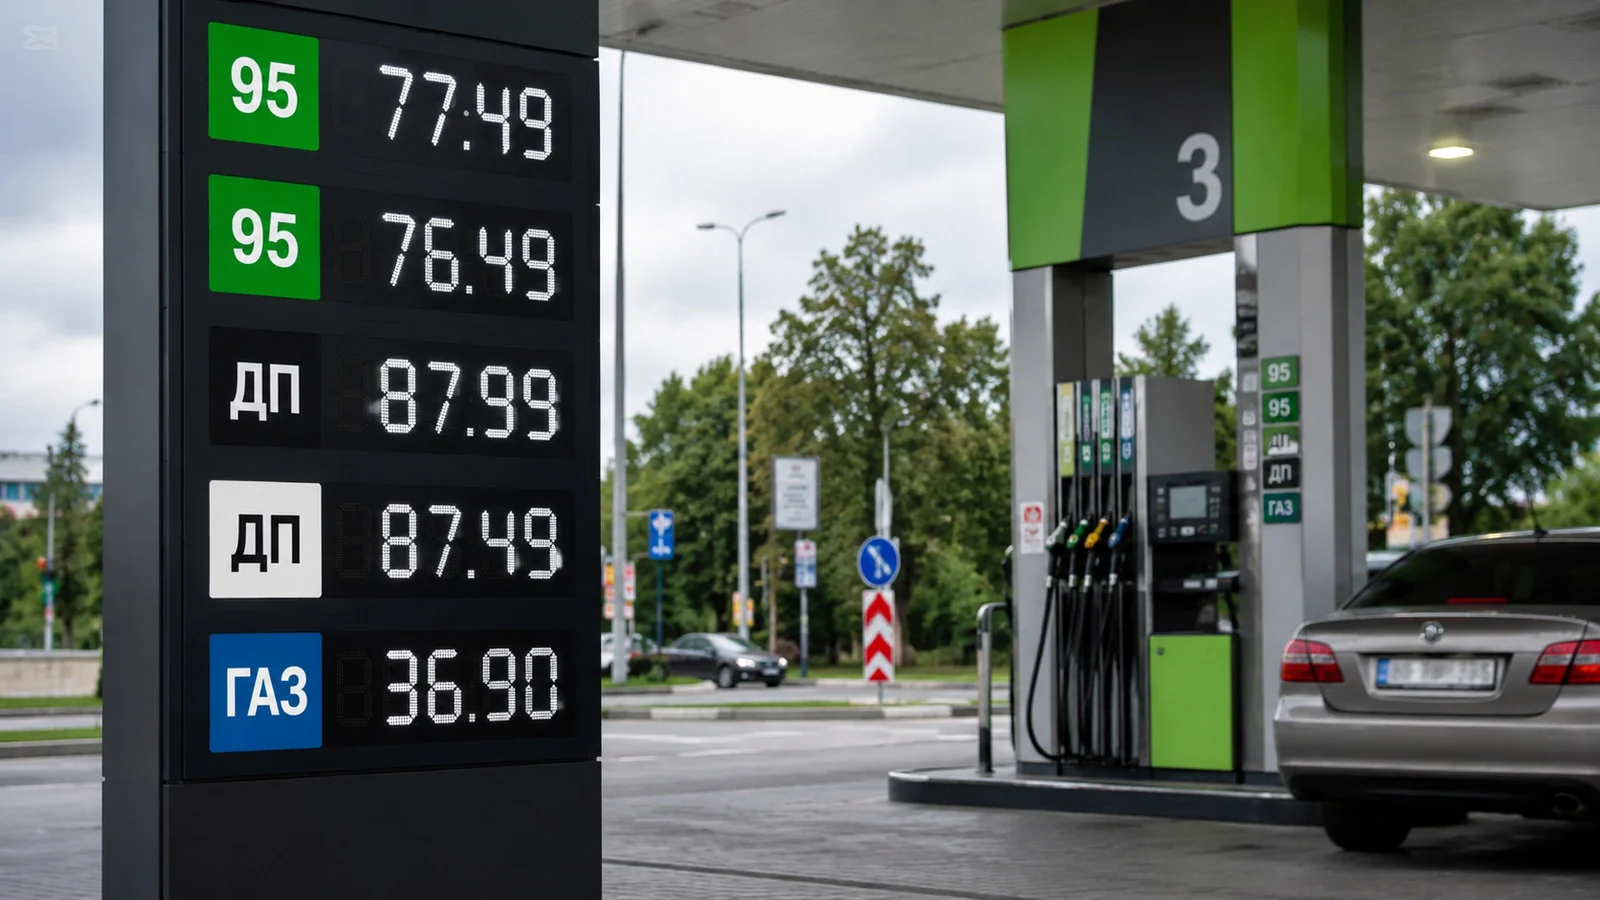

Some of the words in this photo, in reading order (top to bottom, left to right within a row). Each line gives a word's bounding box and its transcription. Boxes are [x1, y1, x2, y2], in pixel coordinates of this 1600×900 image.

[231, 56, 298, 119] 95
[379, 64, 553, 161] 77.49
[1176, 132, 1222, 221] 3
[231, 207, 299, 268] 95
[382, 212, 555, 301] 76.49
[229, 361, 300, 421] ДП
[379, 358, 556, 440] 87.99
[1268, 363, 1291, 383] 95
[1268, 398, 1291, 417] 95
[1268, 464, 1292, 484] ДП
[1268, 500, 1293, 516] ГАЗ
[230, 513, 301, 572] ДП
[381, 503, 557, 579] 87.49
[226, 665, 308, 717] ГАЗ
[386, 647, 557, 725] 36.90
